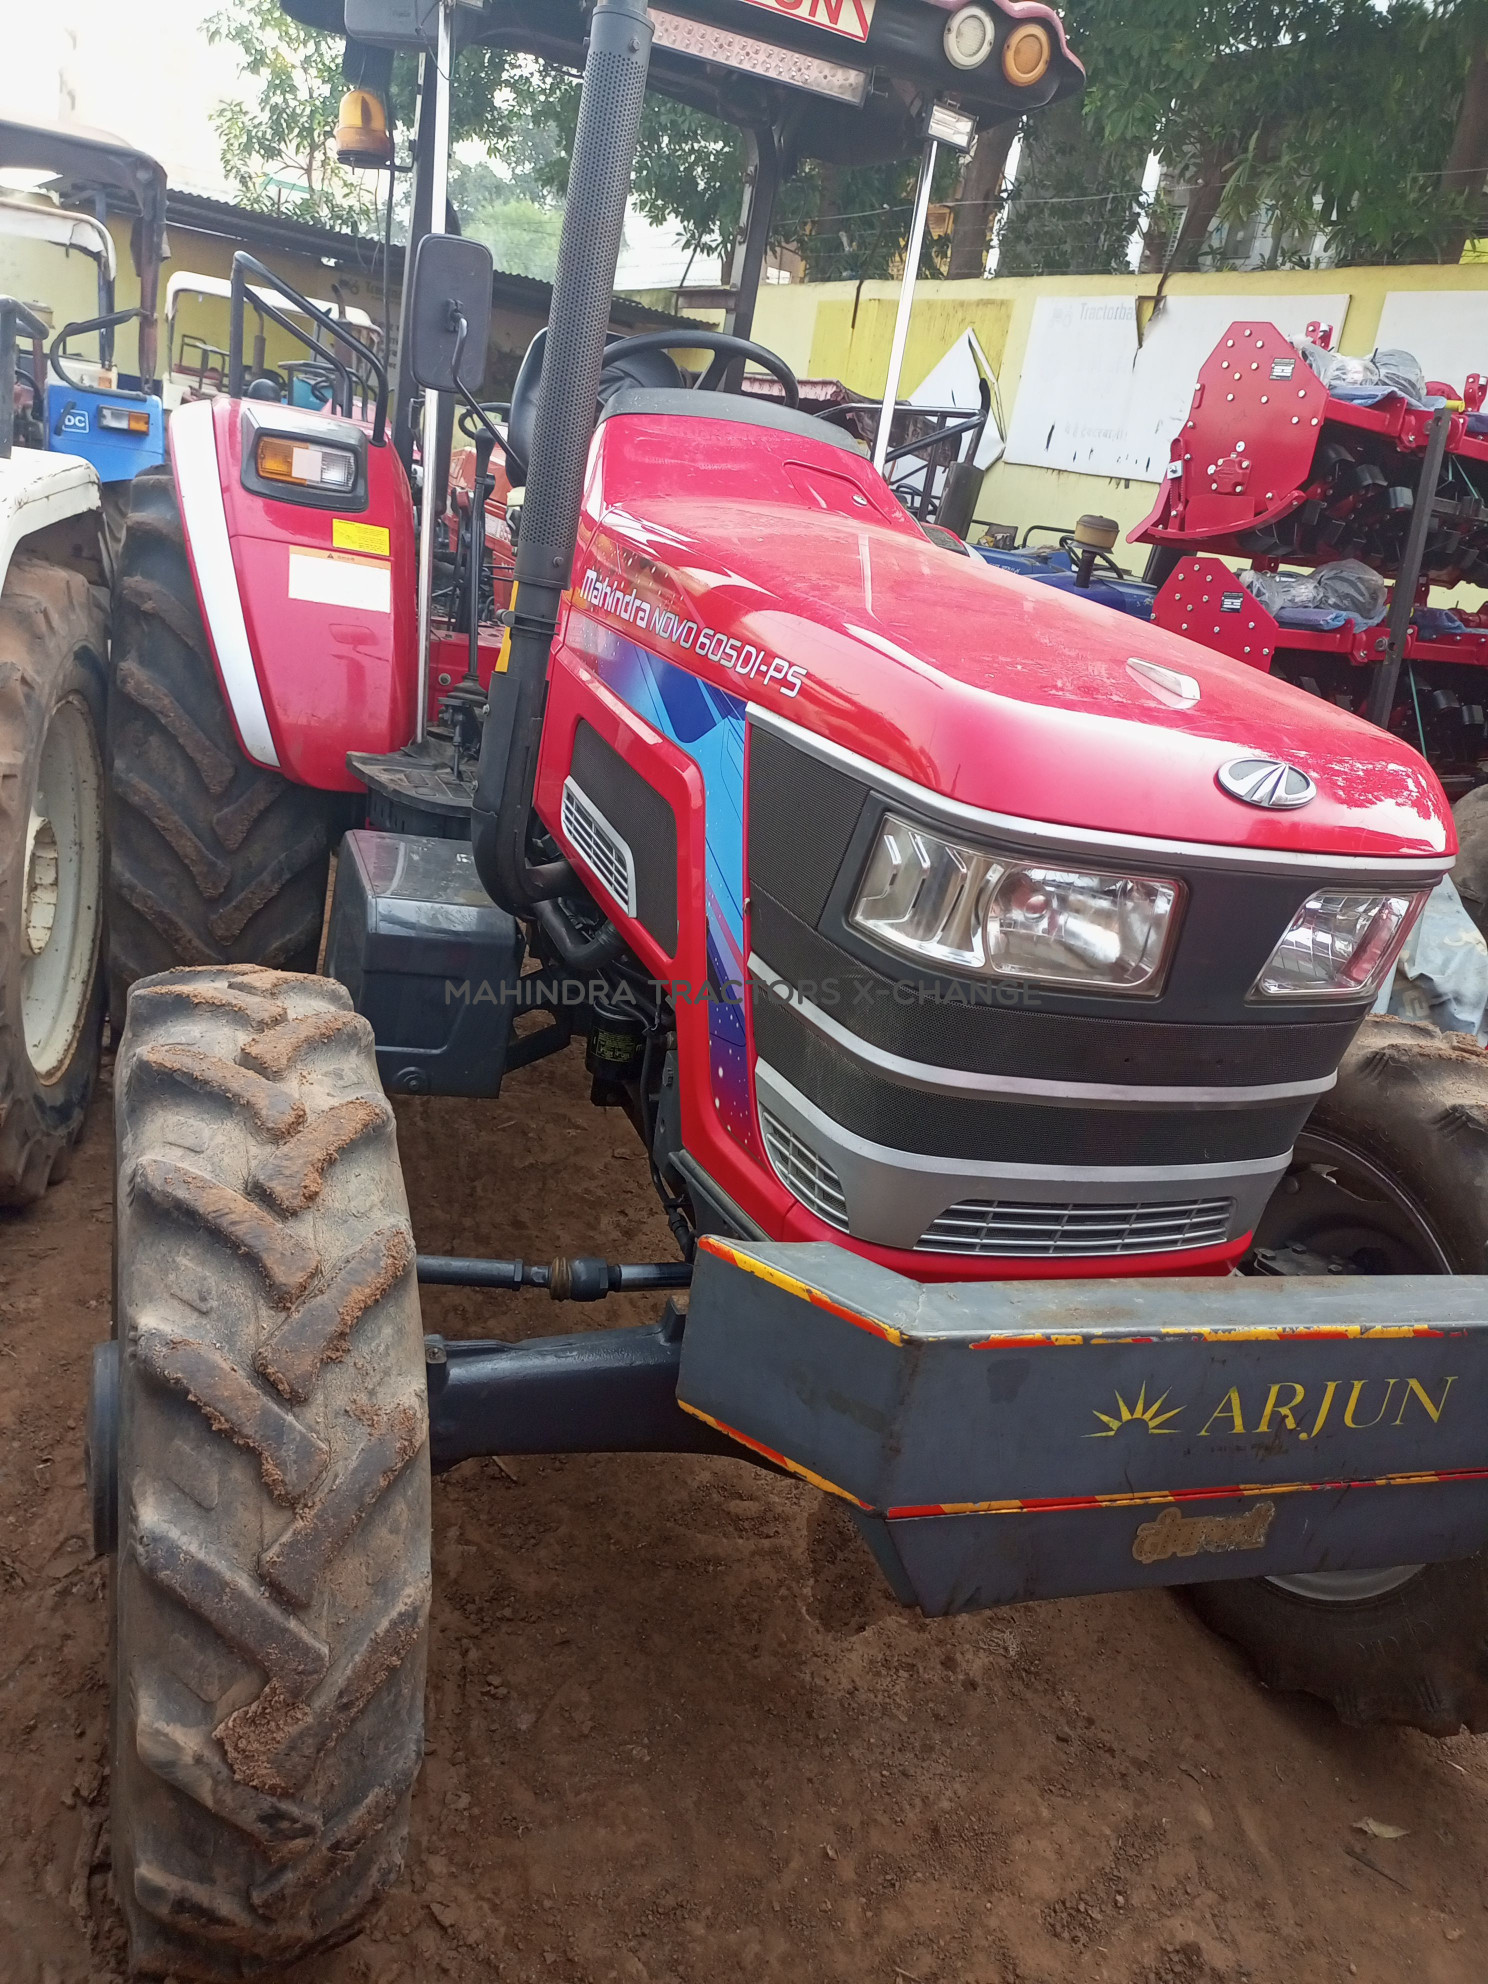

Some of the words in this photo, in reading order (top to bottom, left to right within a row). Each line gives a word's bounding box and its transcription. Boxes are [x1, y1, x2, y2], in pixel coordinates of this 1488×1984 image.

[580, 568, 651, 629] Mahindra
[649, 605, 698, 650] NOVO
[695, 627, 808, 698] 605DI-PS
[1196, 1375, 1459, 1440] ARJUN
